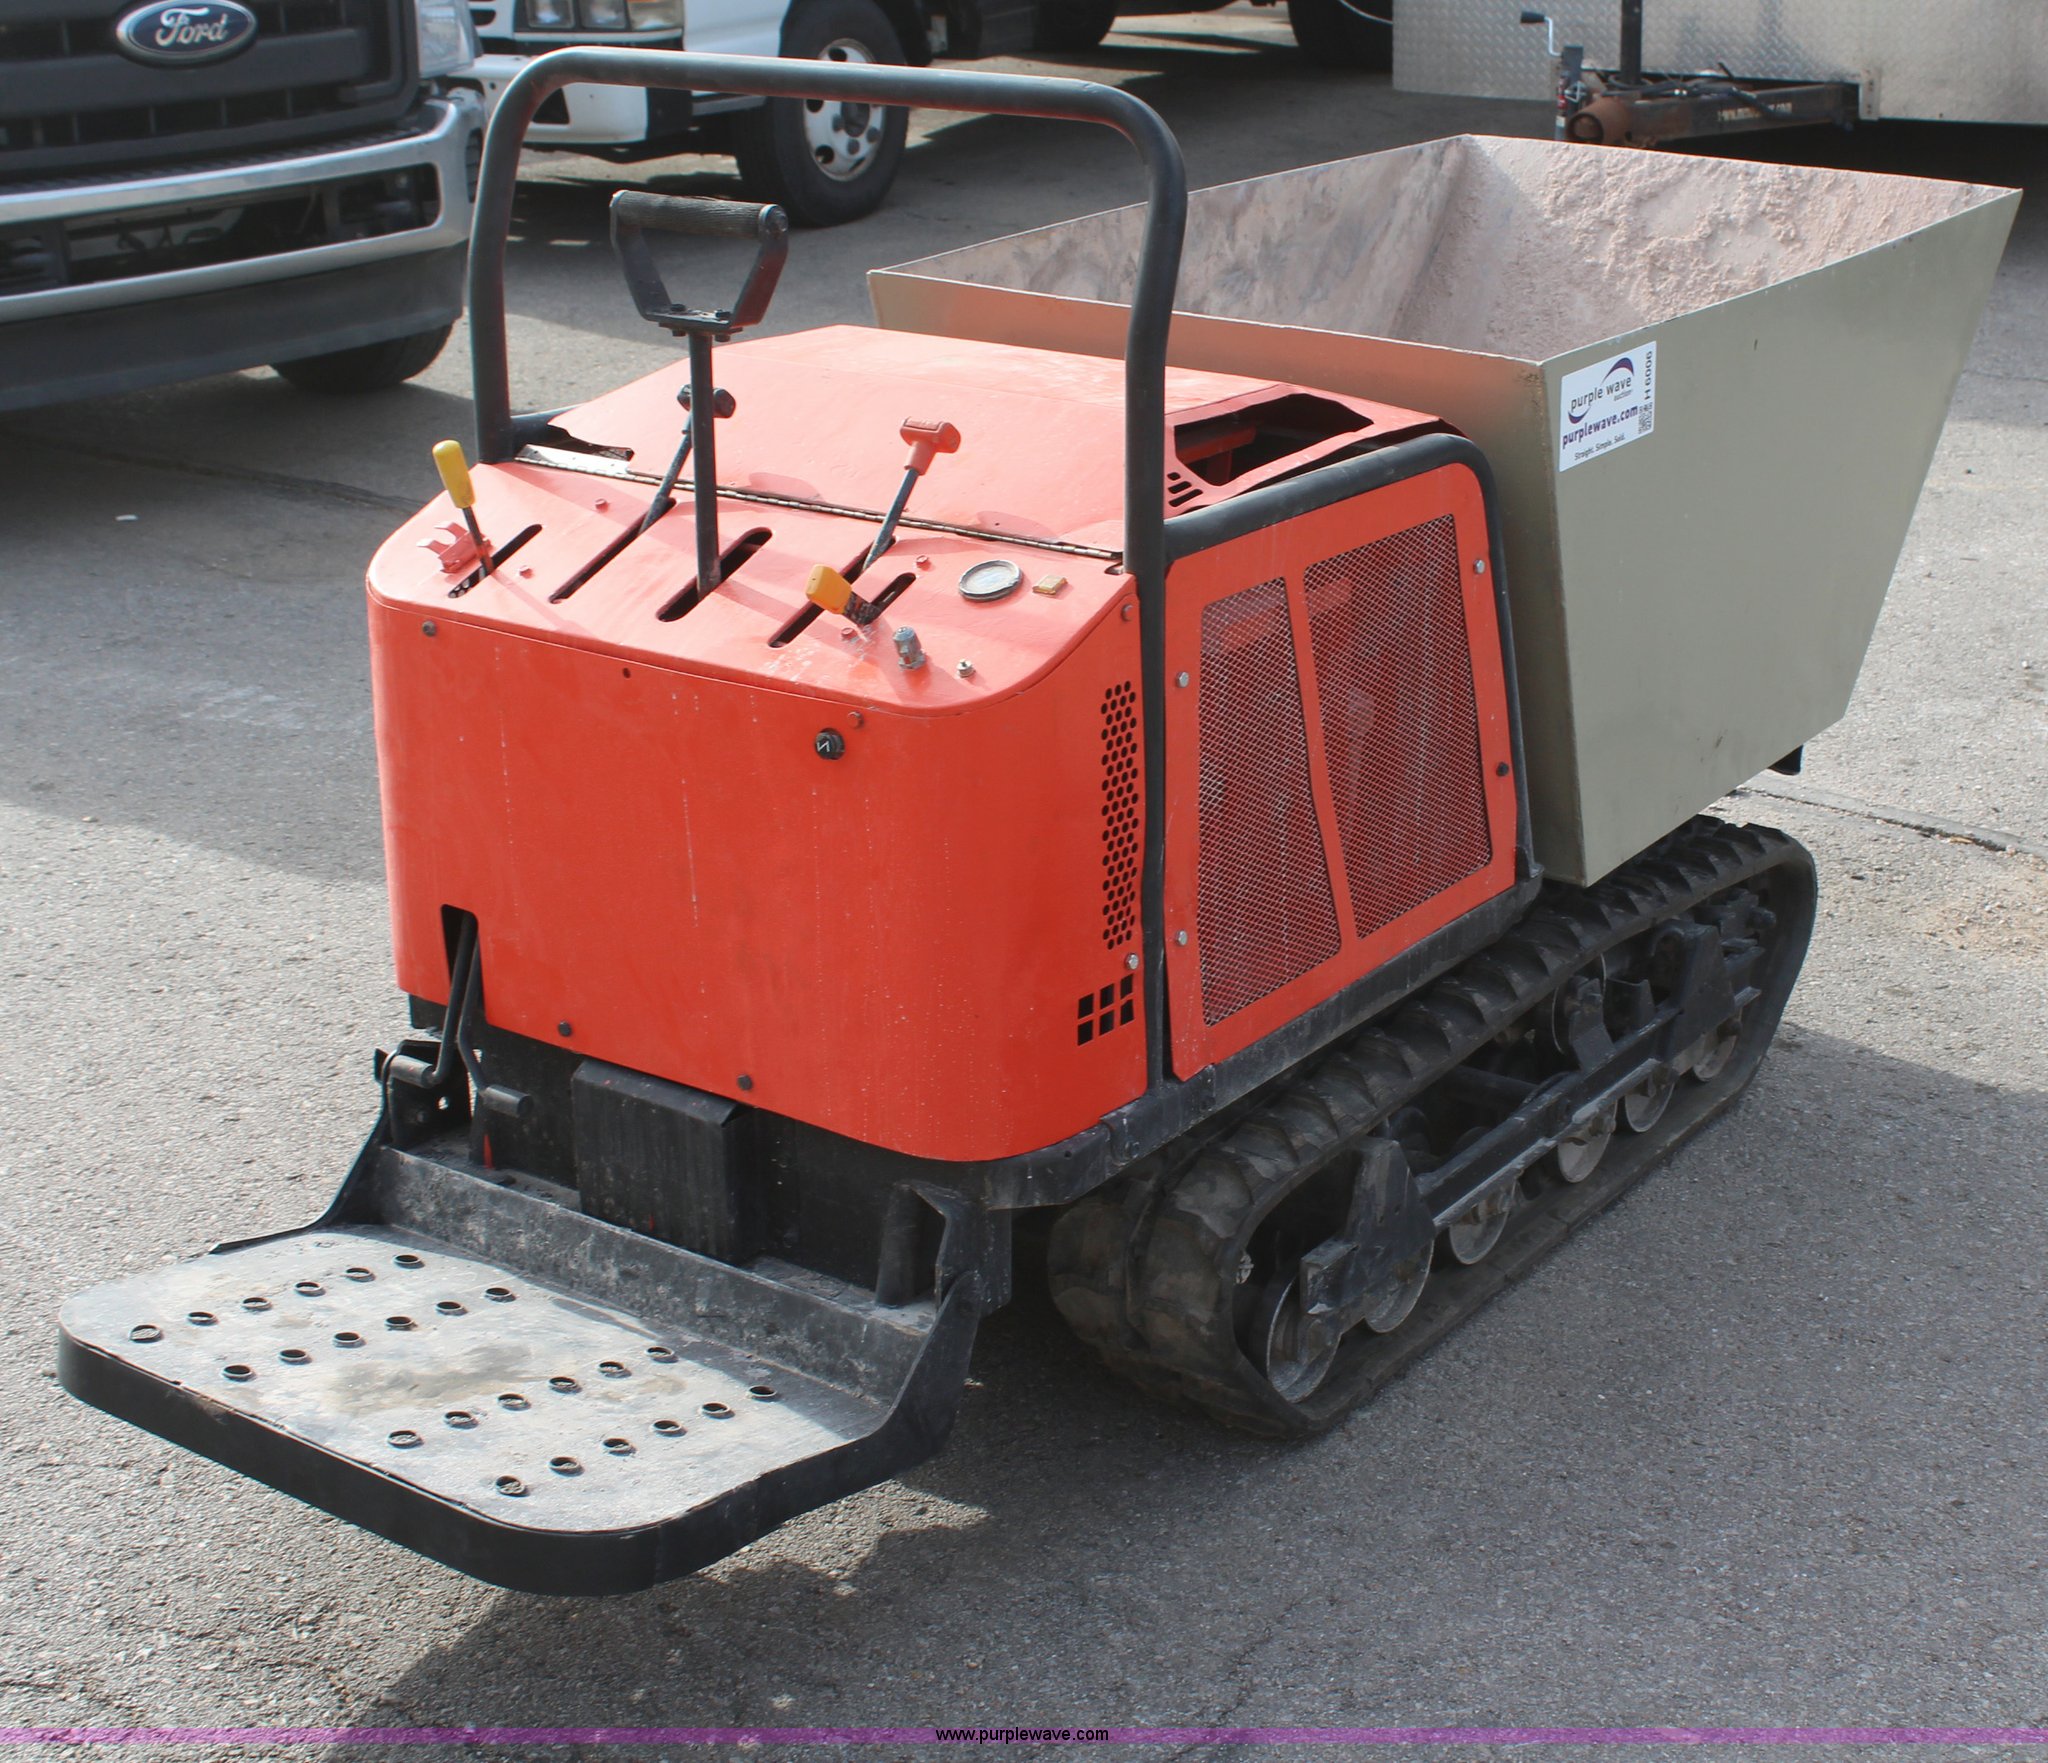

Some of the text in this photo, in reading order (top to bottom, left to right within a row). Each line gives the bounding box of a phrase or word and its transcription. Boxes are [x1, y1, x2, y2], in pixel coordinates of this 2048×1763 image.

[155, 7, 229, 47] Ford
[1571, 386, 1604, 412] purple
[1605, 377, 1632, 396] wave
[1562, 405, 1638, 449] purplewave.com
